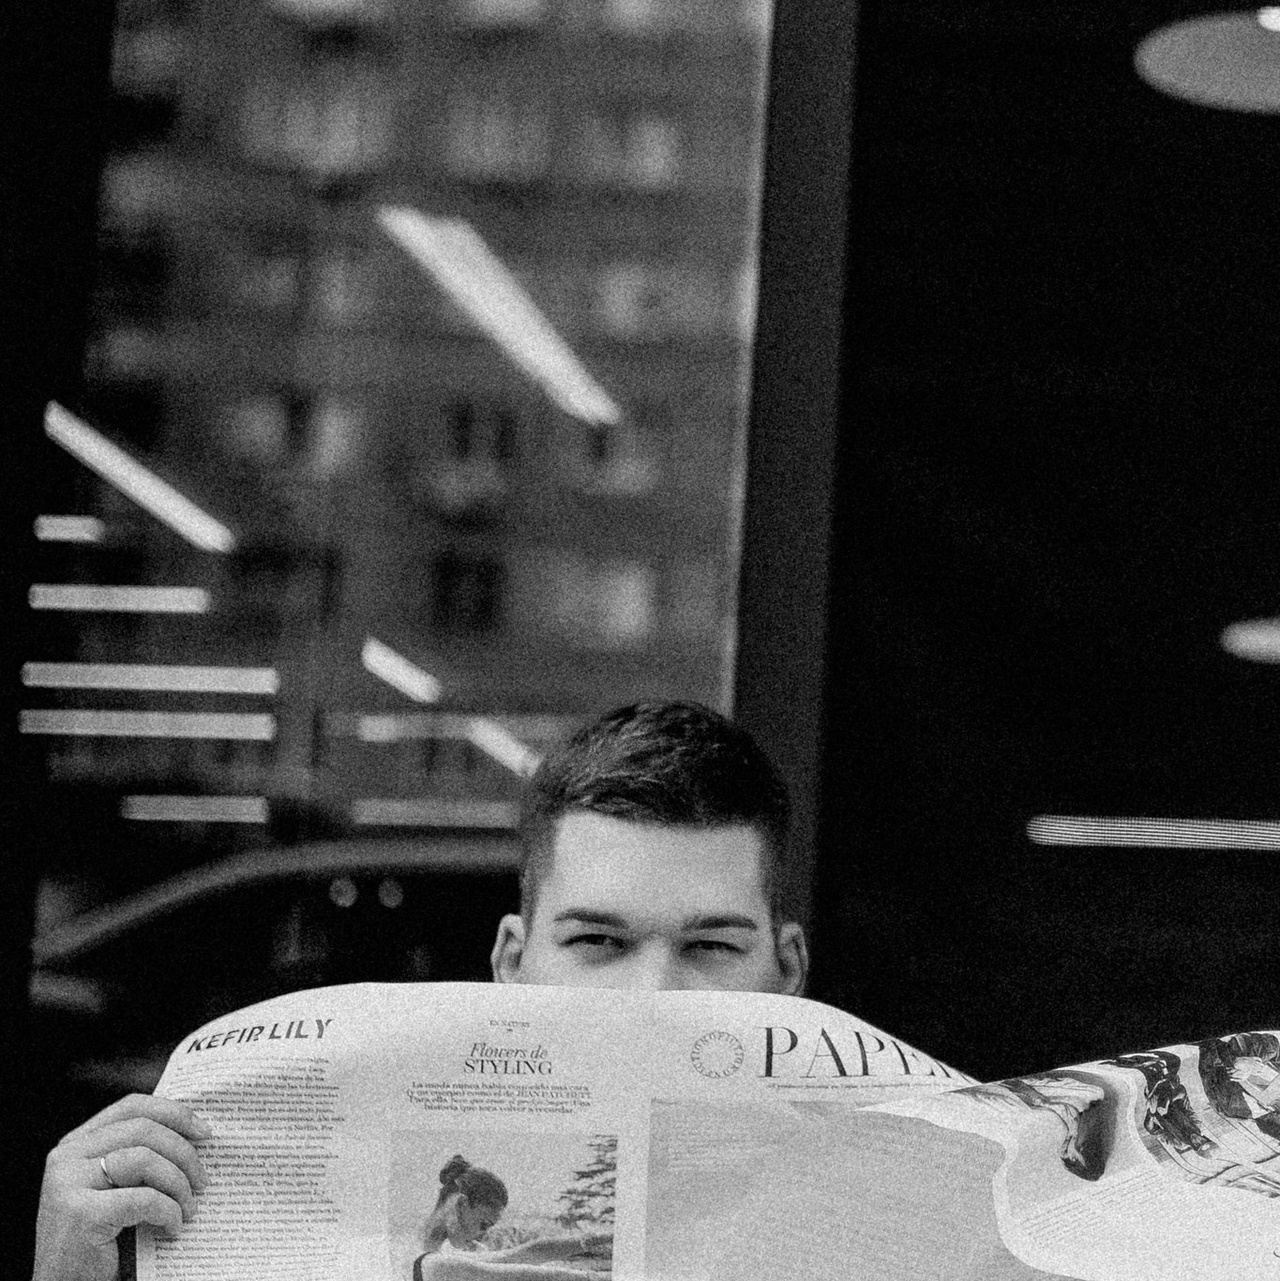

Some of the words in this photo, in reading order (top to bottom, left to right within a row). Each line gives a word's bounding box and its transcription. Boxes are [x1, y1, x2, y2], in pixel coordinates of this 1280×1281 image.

[269, 1018, 334, 1040] LILY
[470, 1042, 527, 1059] Flowers
[530, 1045, 548, 1059] de
[464, 1059, 552, 1075] STYLING
